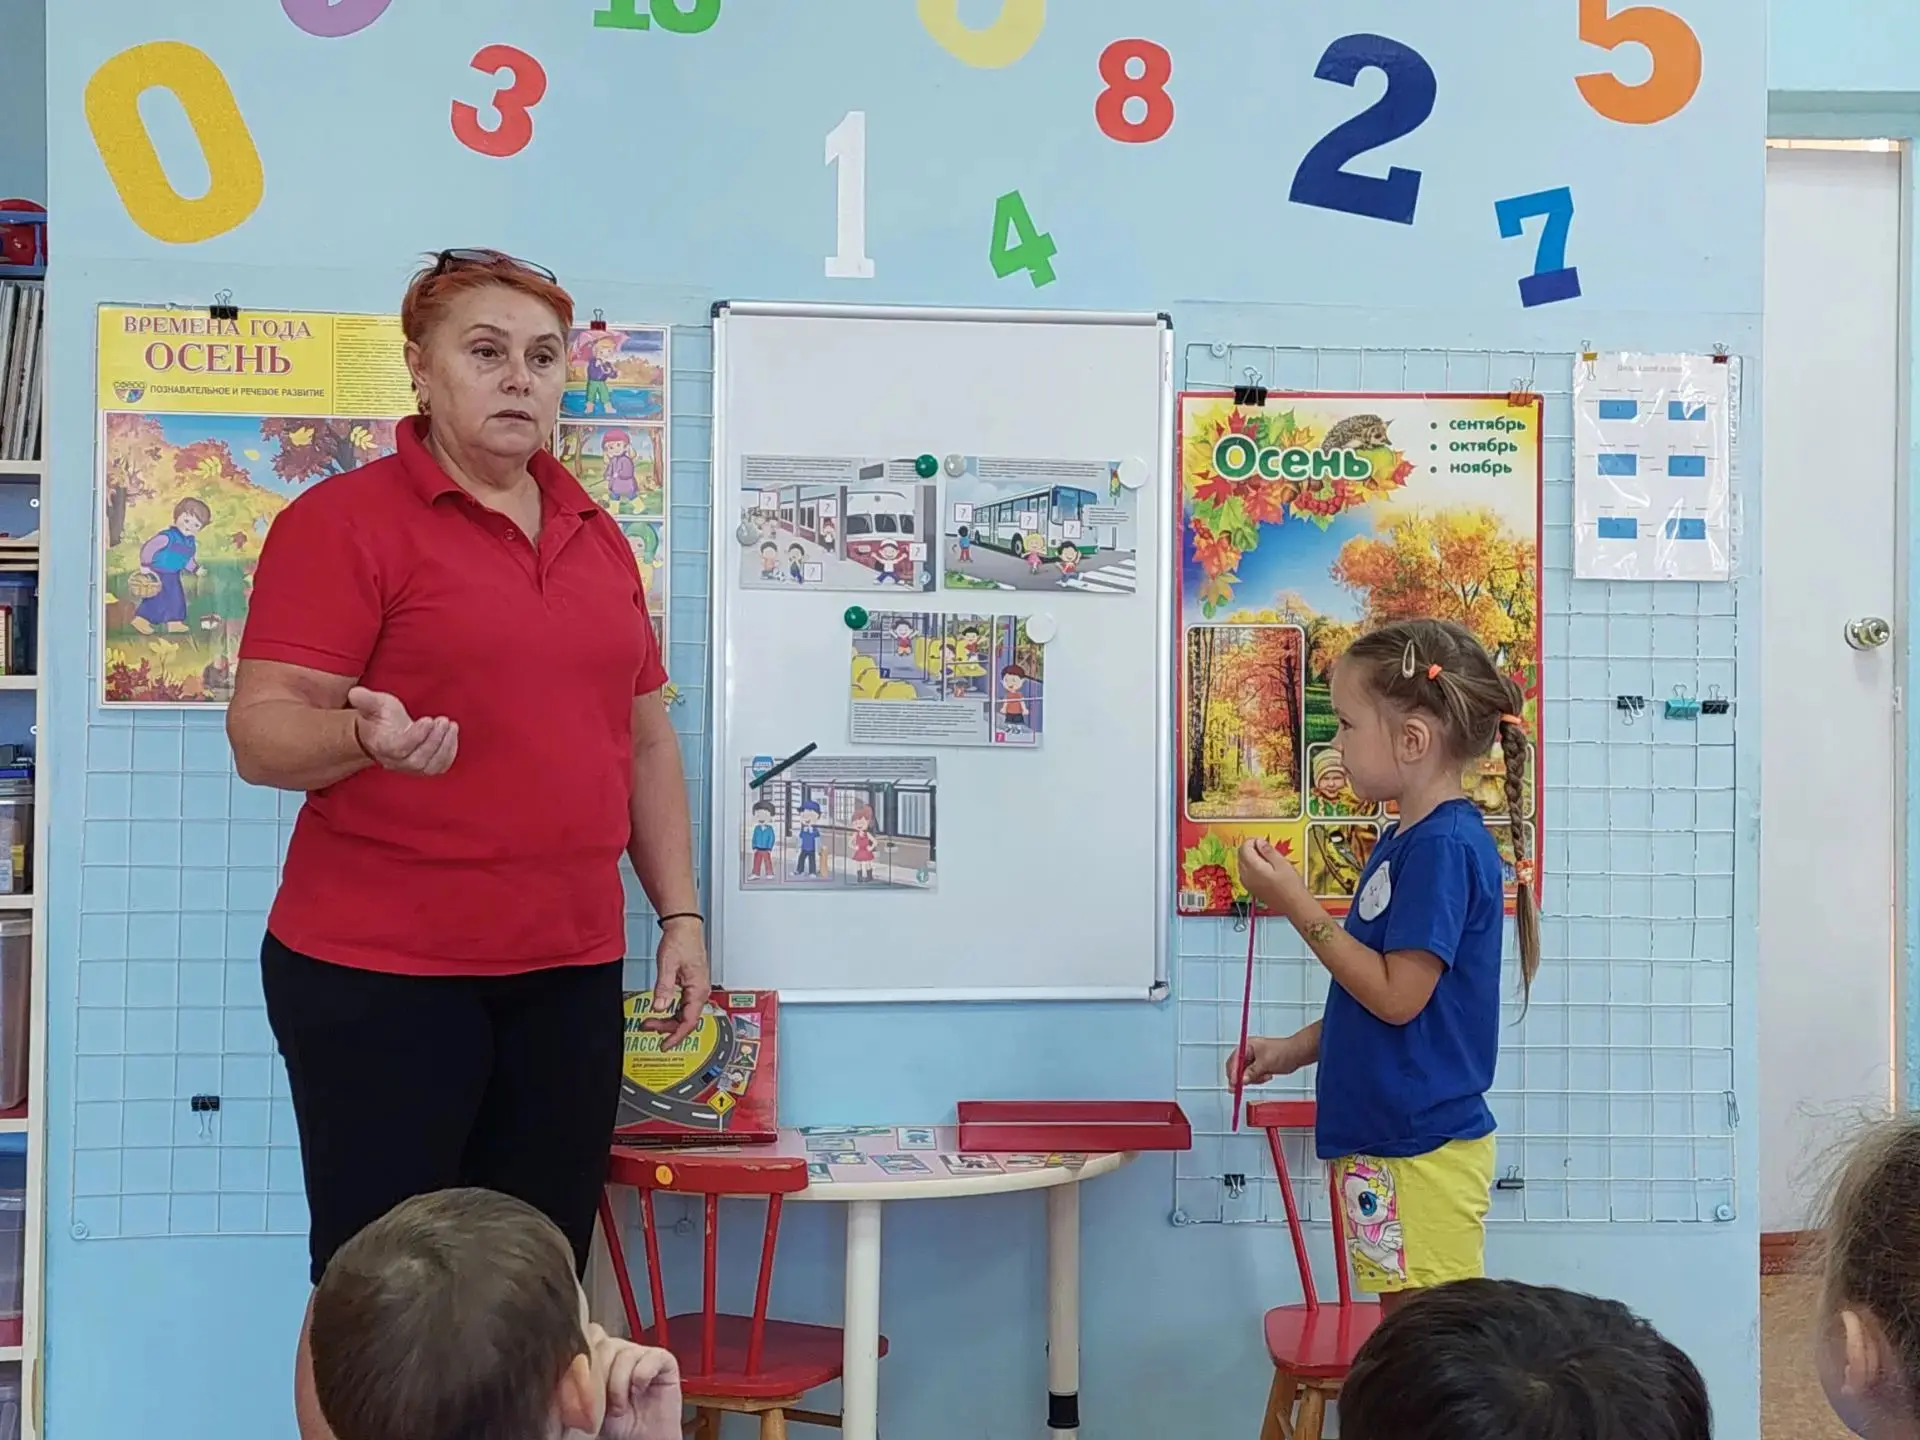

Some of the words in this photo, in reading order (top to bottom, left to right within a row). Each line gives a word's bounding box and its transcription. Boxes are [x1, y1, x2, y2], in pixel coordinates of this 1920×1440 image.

[450, 44, 548, 158] 3
[1094, 38, 1176, 144] 8
[1575, 0, 1703, 125] 5
[84, 40, 264, 244] 0
[1288, 33, 1438, 226] 2
[824, 111, 875, 279] 1
[989, 189, 1057, 288] 4
[1494, 186, 1582, 308] 7
[124, 316, 241, 337] ВРЕМЕНА
[250, 320, 313, 341] ГОДА
[145, 341, 293, 376] ОСЕНЬ
[150, 385, 231, 396] ПОЗНАВАТЕЛЬНОЕ
[232, 387, 239, 395] И
[241, 387, 280, 397] РЕЧЕВОЕ
[281, 388, 325, 398] РАЗВИТИЕ
[1449, 415, 1526, 432] сентябрь
[1214, 433, 1372, 481] Осень
[1449, 438, 1518, 453] октябрь
[1450, 460, 1513, 475] ноябрь
